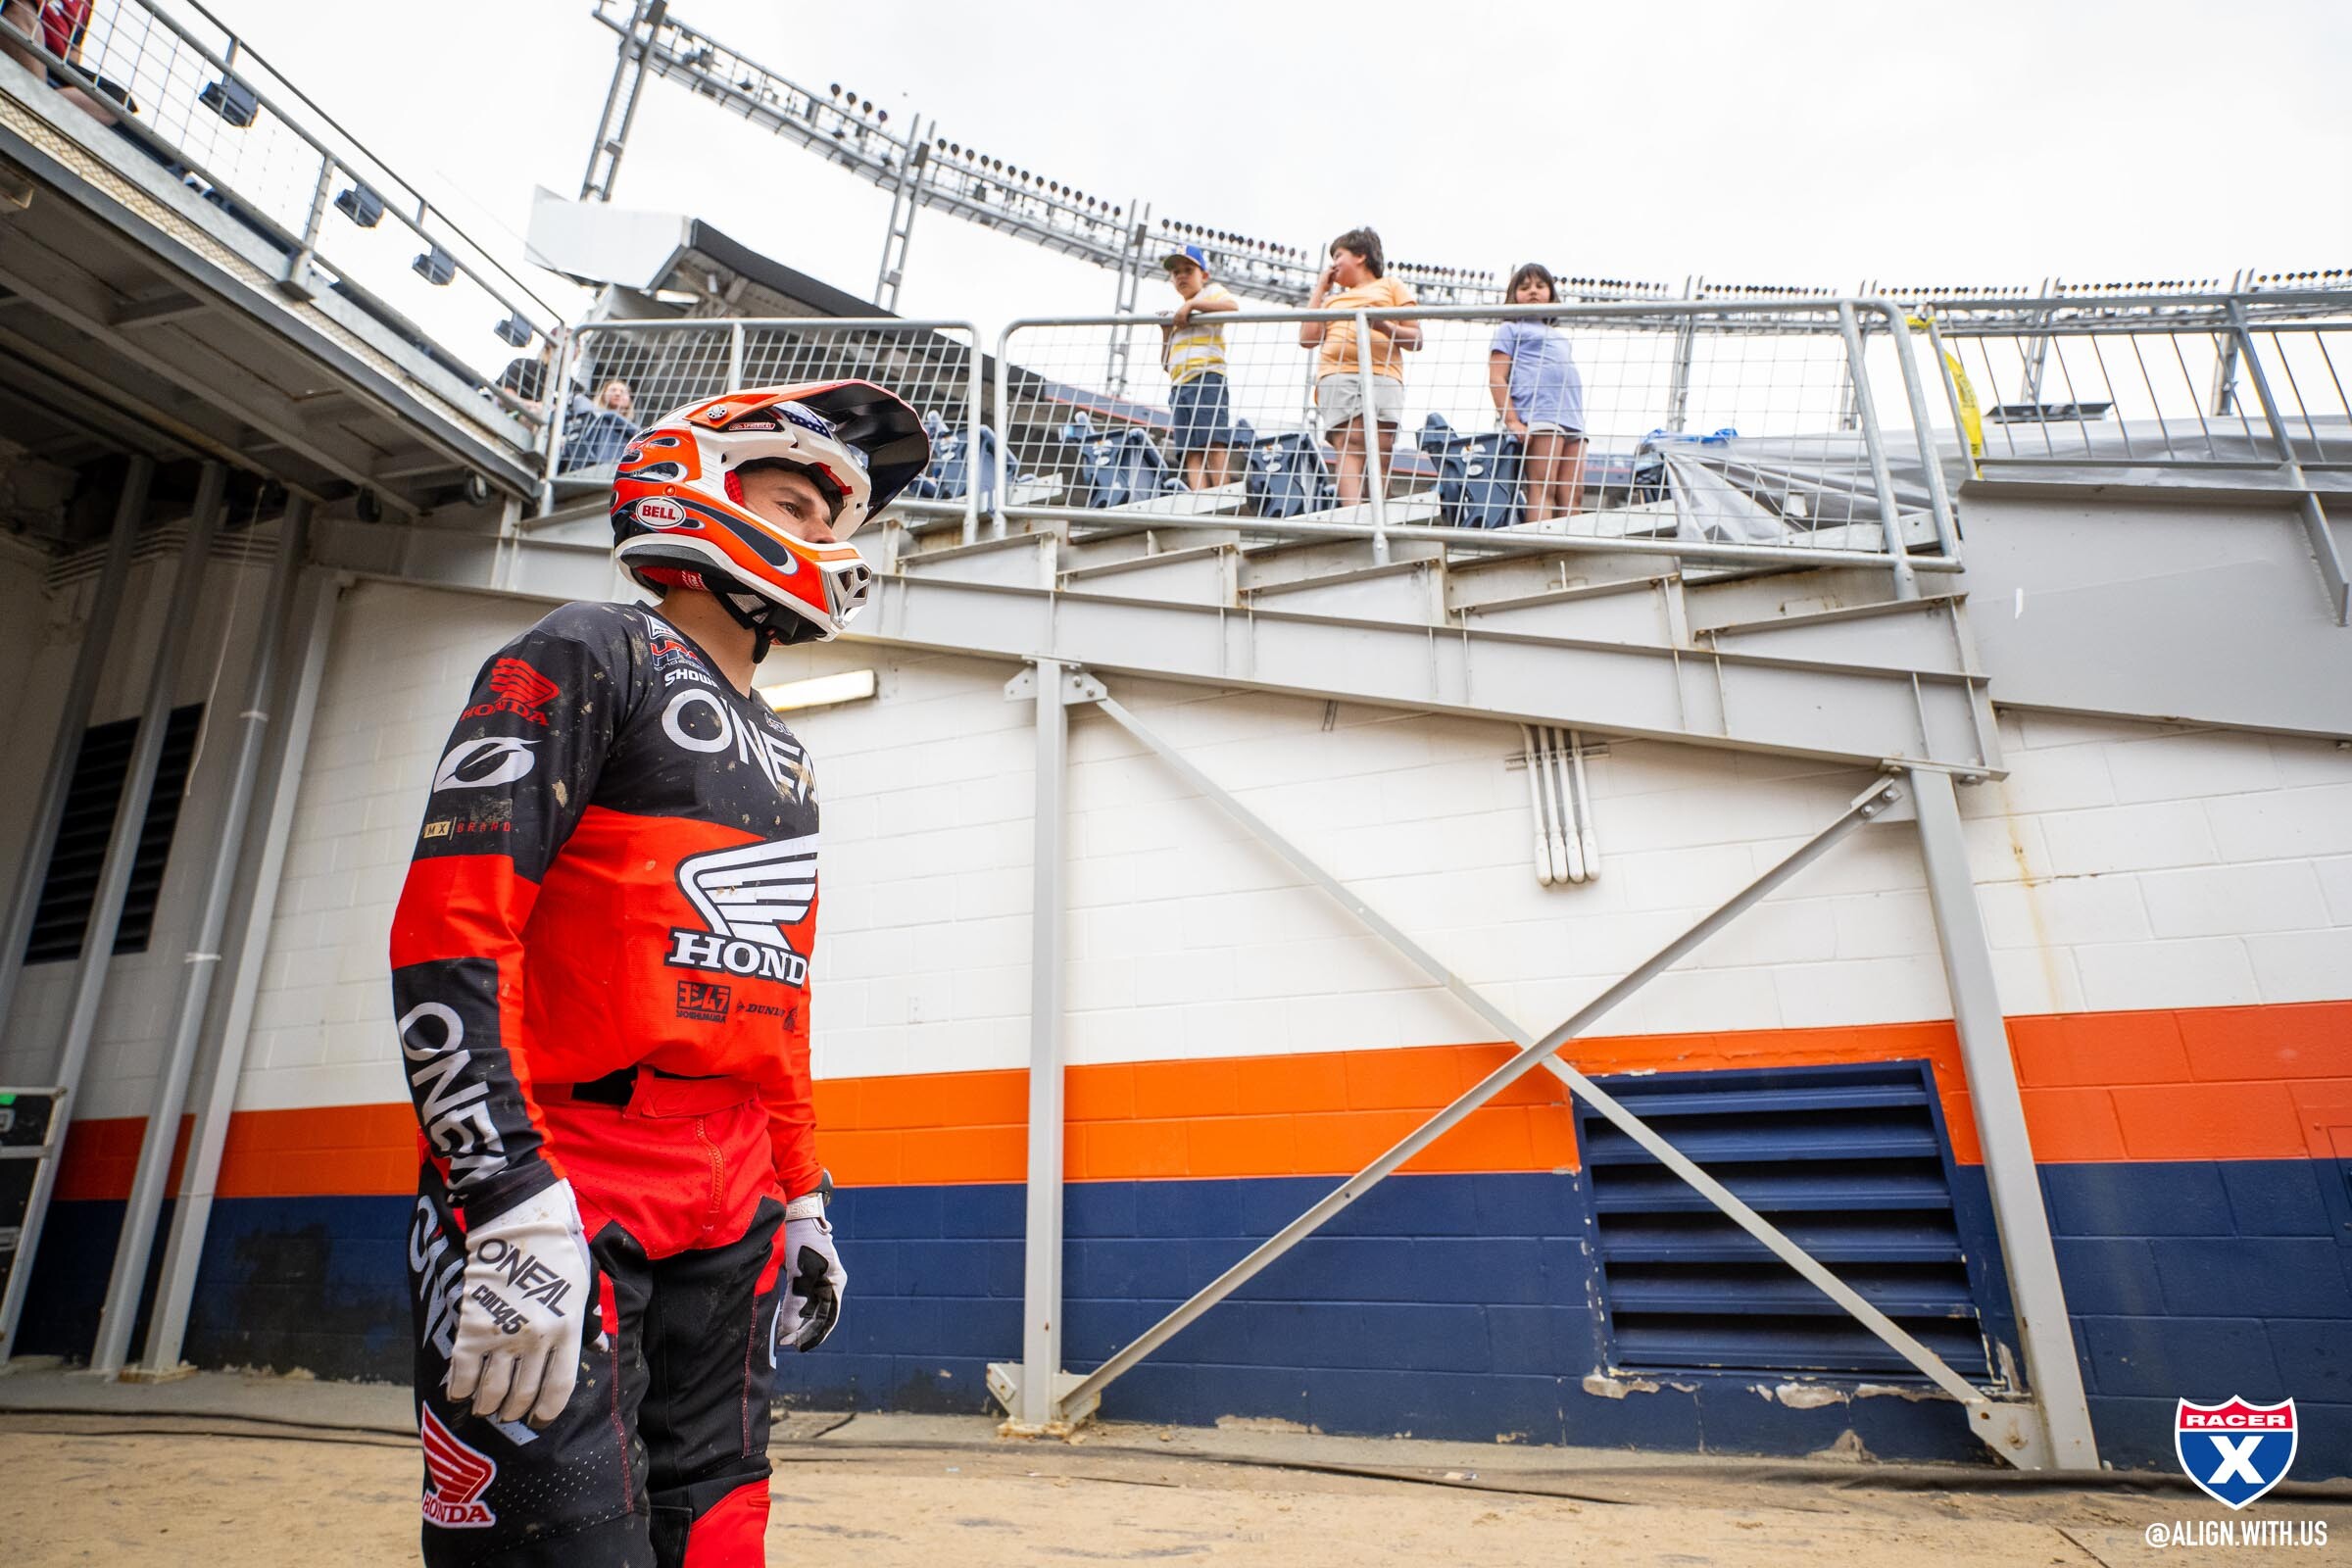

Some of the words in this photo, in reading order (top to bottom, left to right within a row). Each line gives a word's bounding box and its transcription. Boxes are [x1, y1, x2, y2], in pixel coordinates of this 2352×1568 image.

[642, 505, 676, 520] BELL
[460, 698, 549, 726] HONDA
[662, 688, 819, 808] O'NEA
[427, 823, 447, 836] MX
[668, 931, 808, 986] HOND
[477, 1238, 571, 1317] O'NEAL
[423, 1493, 491, 1523] HONDA
